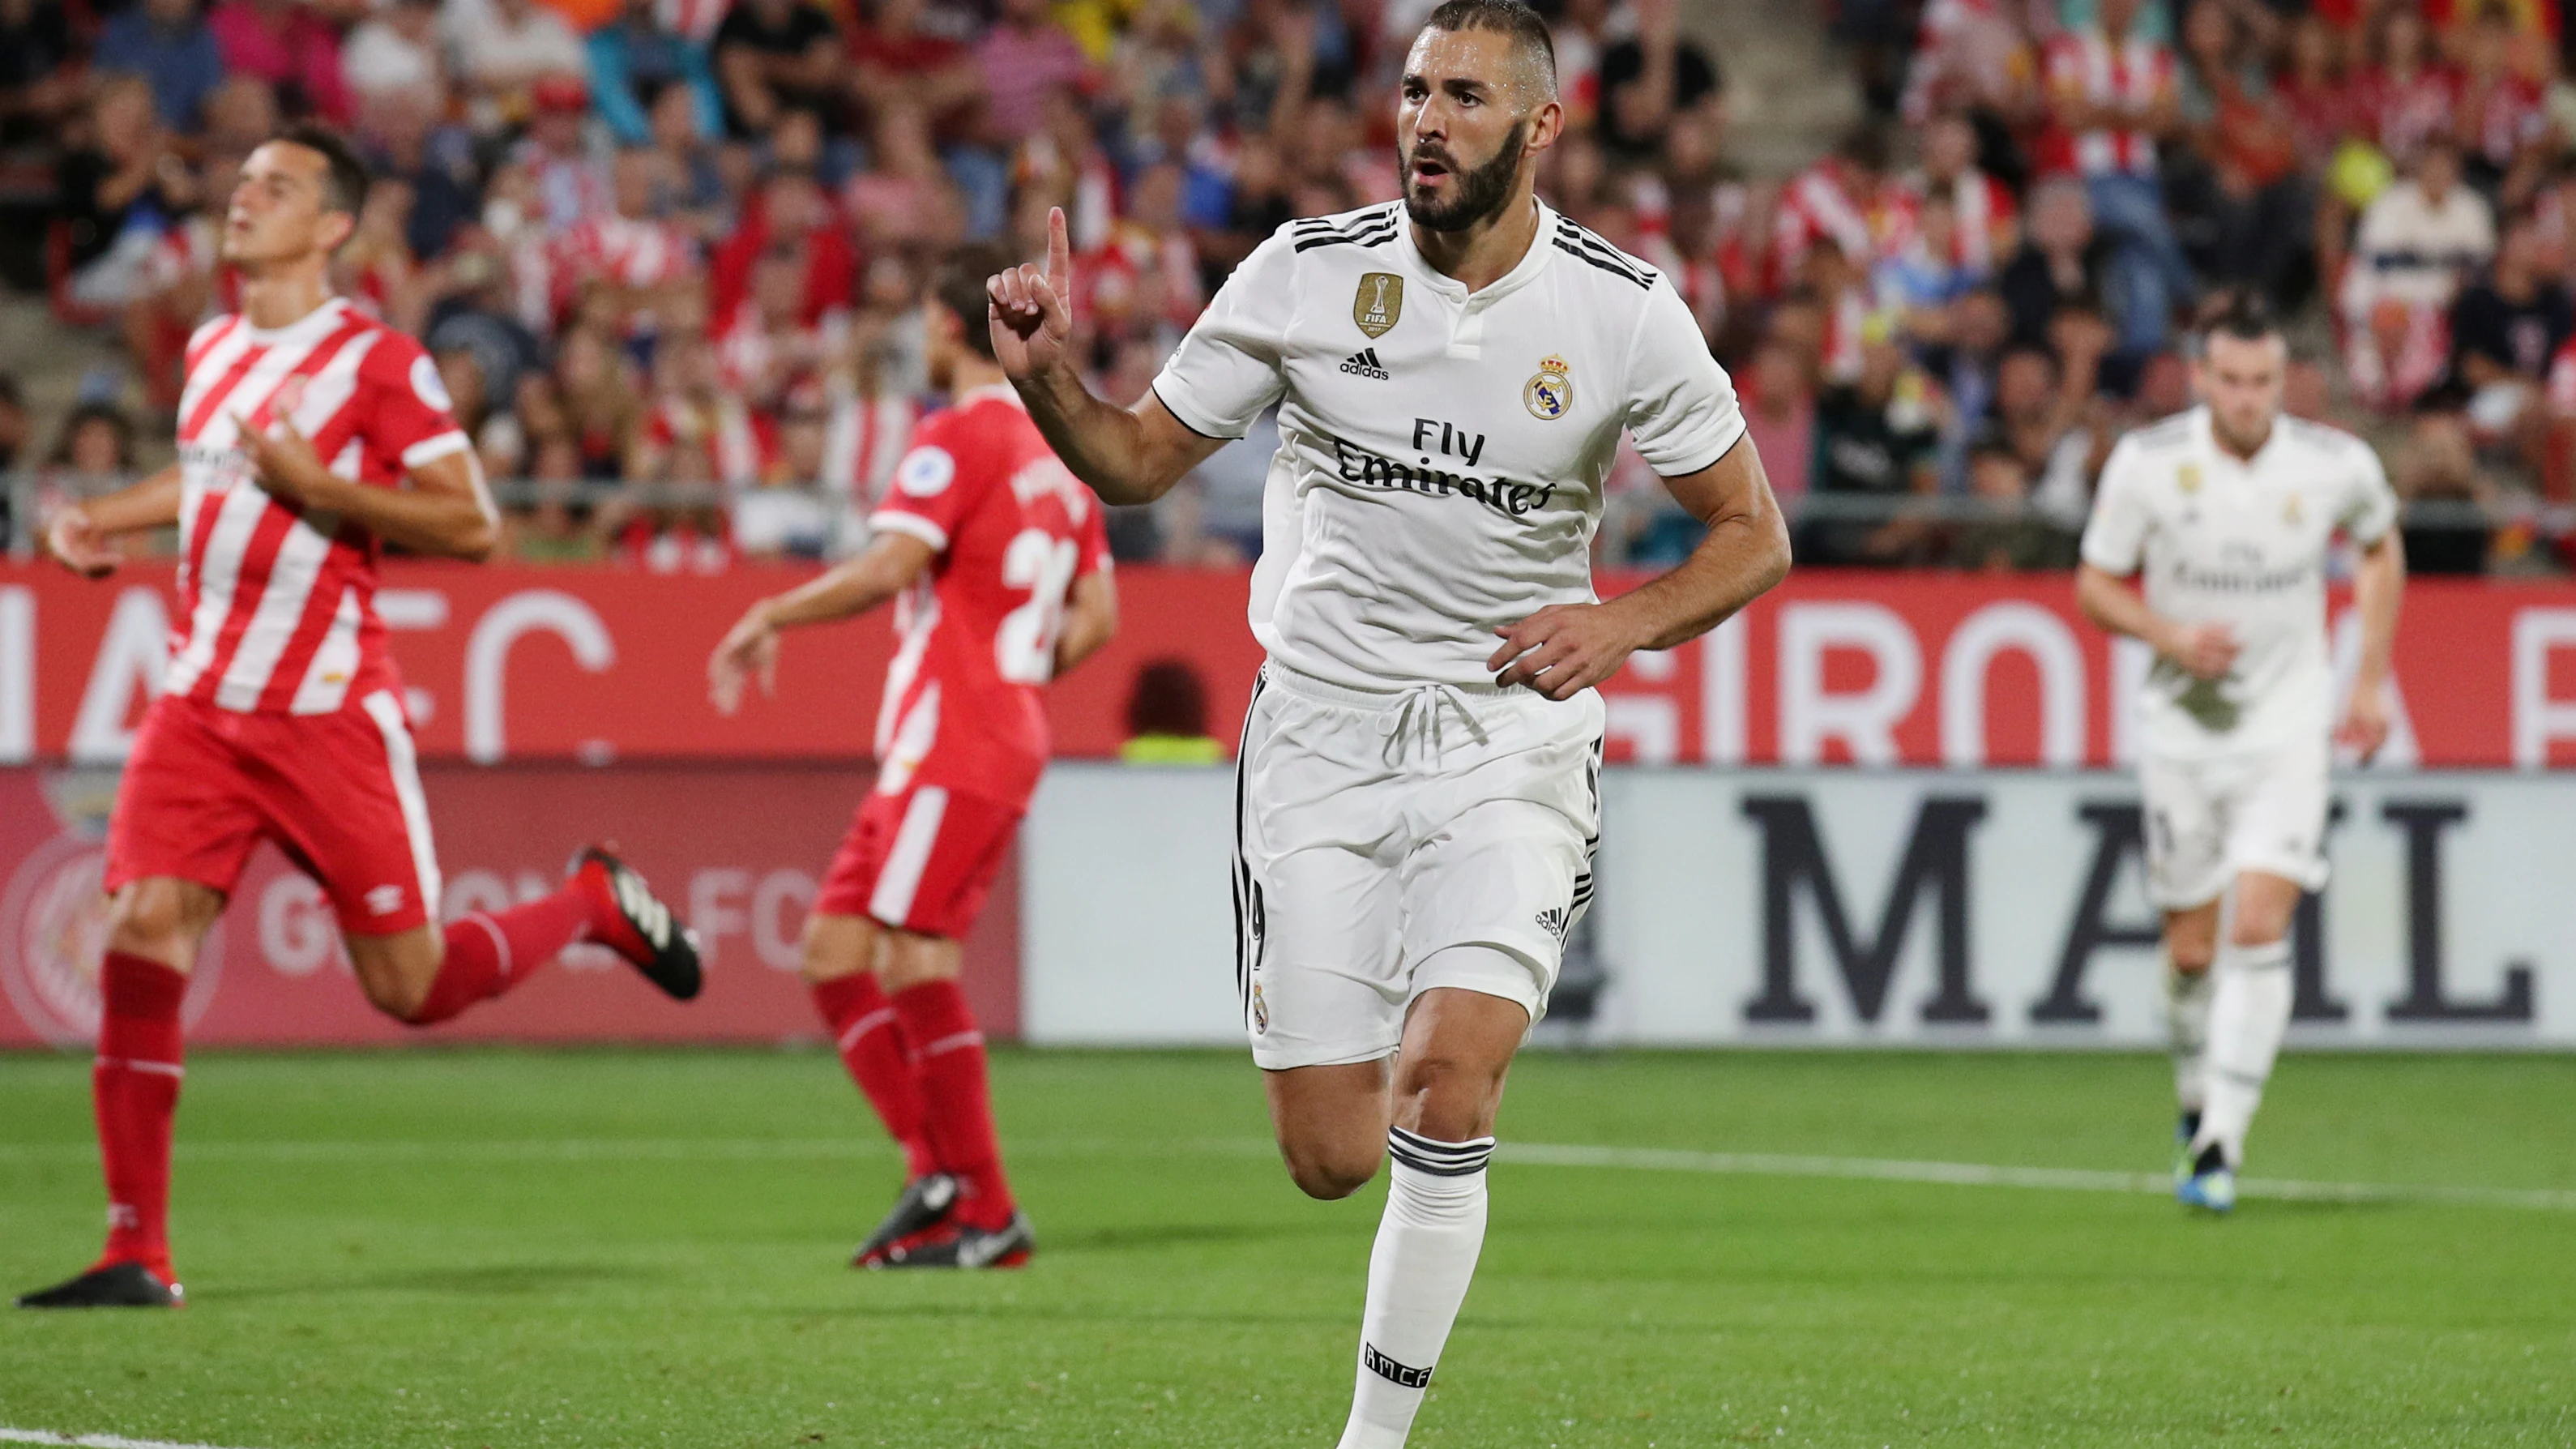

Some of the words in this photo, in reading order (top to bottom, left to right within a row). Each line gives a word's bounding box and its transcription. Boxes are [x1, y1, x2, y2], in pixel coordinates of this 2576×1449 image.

[1365, 314, 1387, 324] FIFA
[1339, 362, 1390, 381] adidas
[1413, 417, 1485, 467] Fly
[1333, 435, 1557, 515] Emirates
[1604, 598, 2426, 767] IROA
[1535, 914, 1561, 947] adida
[1366, 1344, 1430, 1387] RMCF
